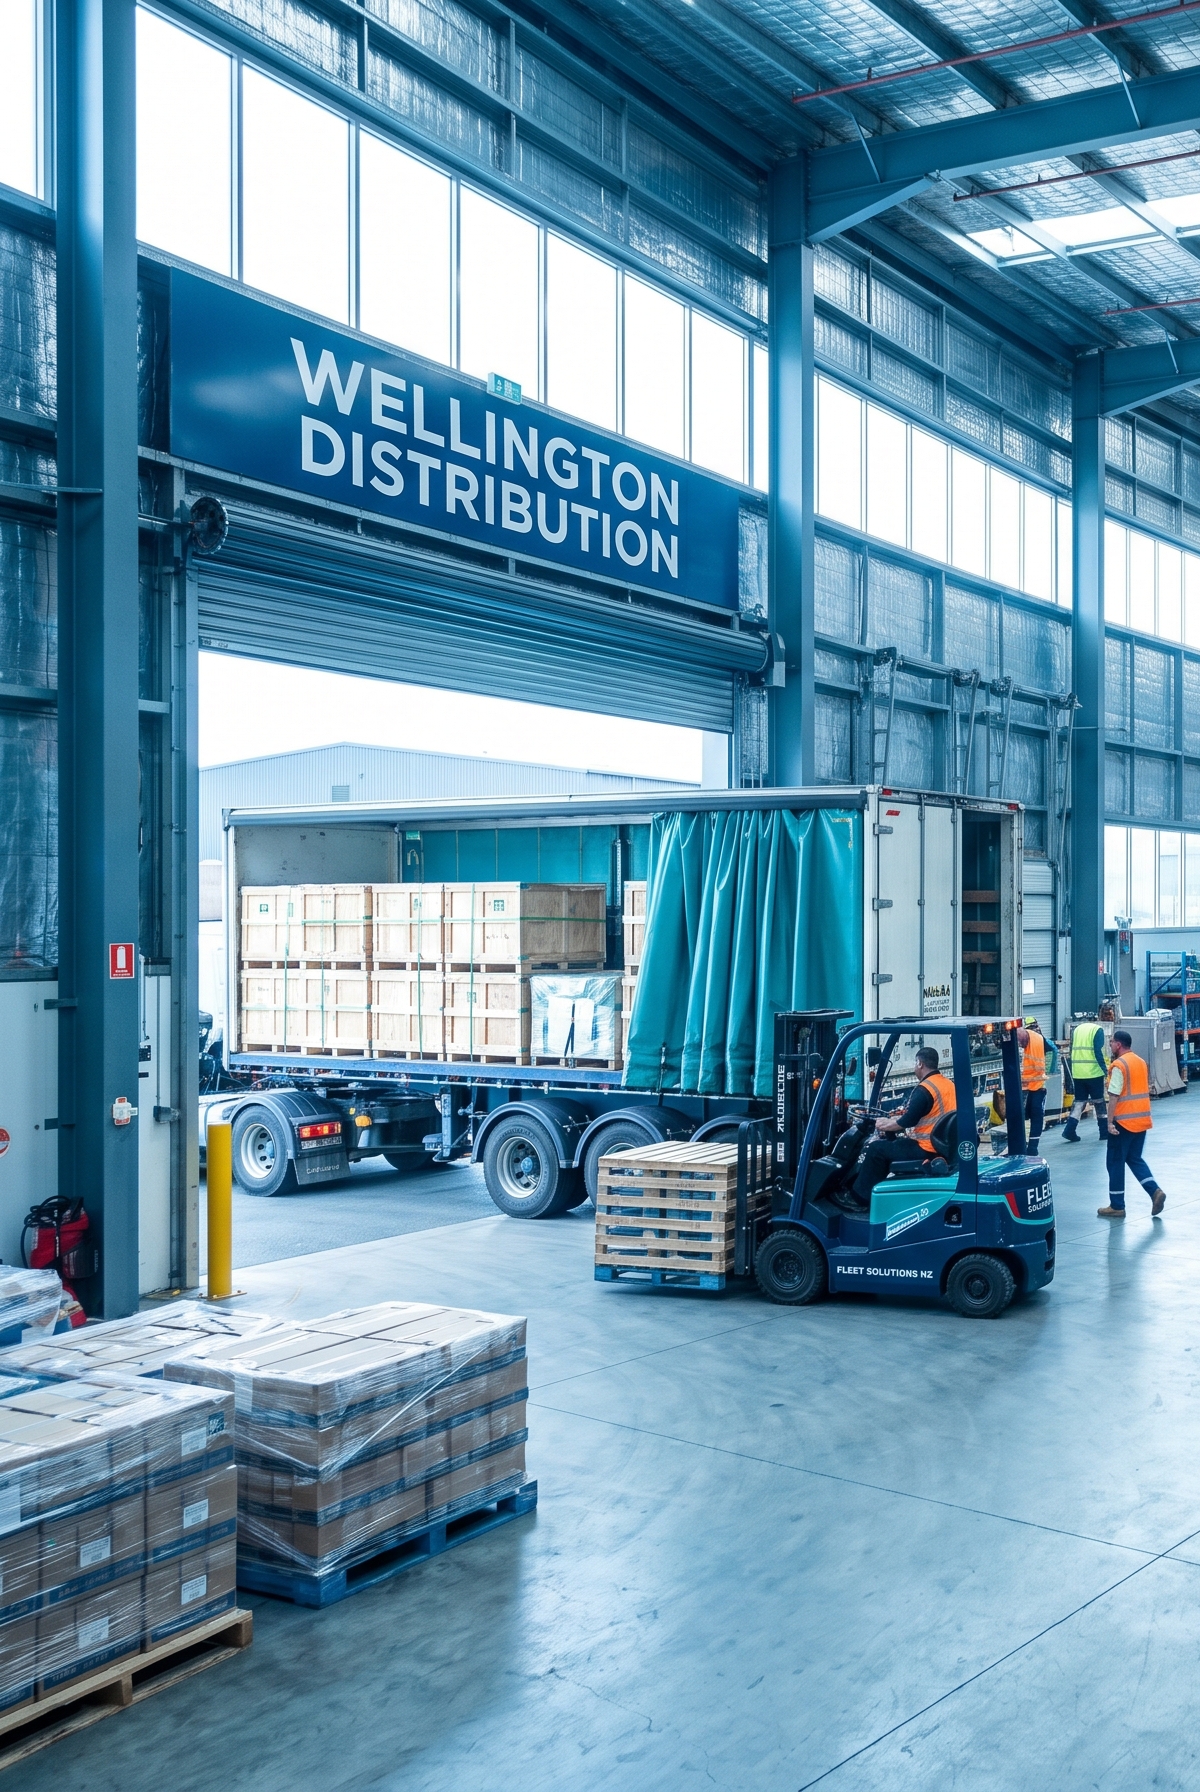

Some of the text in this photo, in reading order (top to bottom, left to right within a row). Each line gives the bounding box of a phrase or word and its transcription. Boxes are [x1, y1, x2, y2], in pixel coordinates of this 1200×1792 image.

[290, 337, 679, 526] WELLINGTON
[301, 414, 679, 579] DISTRIBUTION
[836, 1266, 934, 1279] FLEET SOLUTIONS NZ
